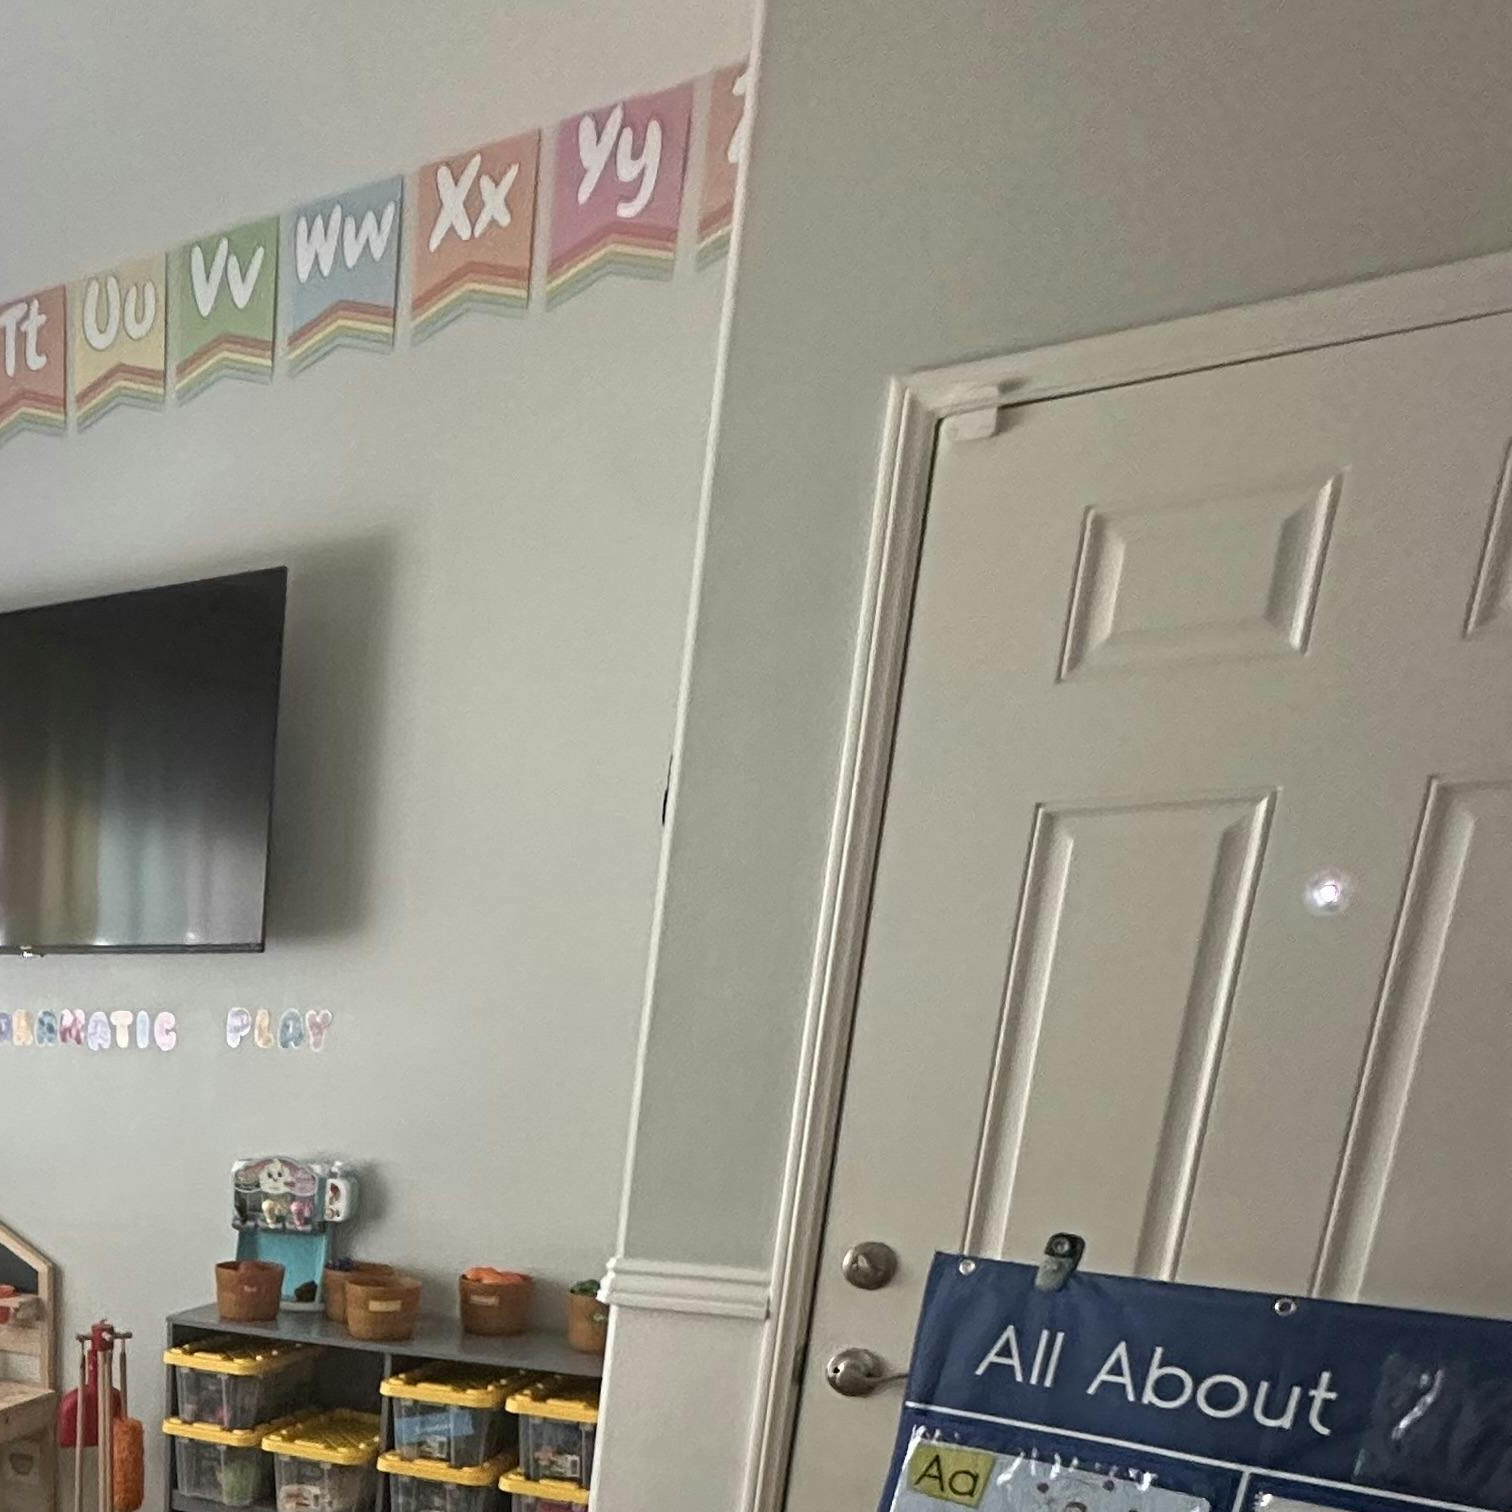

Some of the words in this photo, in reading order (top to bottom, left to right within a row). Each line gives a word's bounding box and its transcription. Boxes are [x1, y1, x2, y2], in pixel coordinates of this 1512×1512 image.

[577, 102, 663, 218] Yy
[295, 200, 397, 284] Ww
[428, 152, 520, 253] Xx
[83, 274, 157, 350] Uu
[190, 237, 265, 318] Vv
[225, 1006, 333, 1052] PLAY
[975, 1324, 1065, 1388] All
[1087, 1341, 1338, 1437] About
[913, 1455, 980, 1499] Aa
